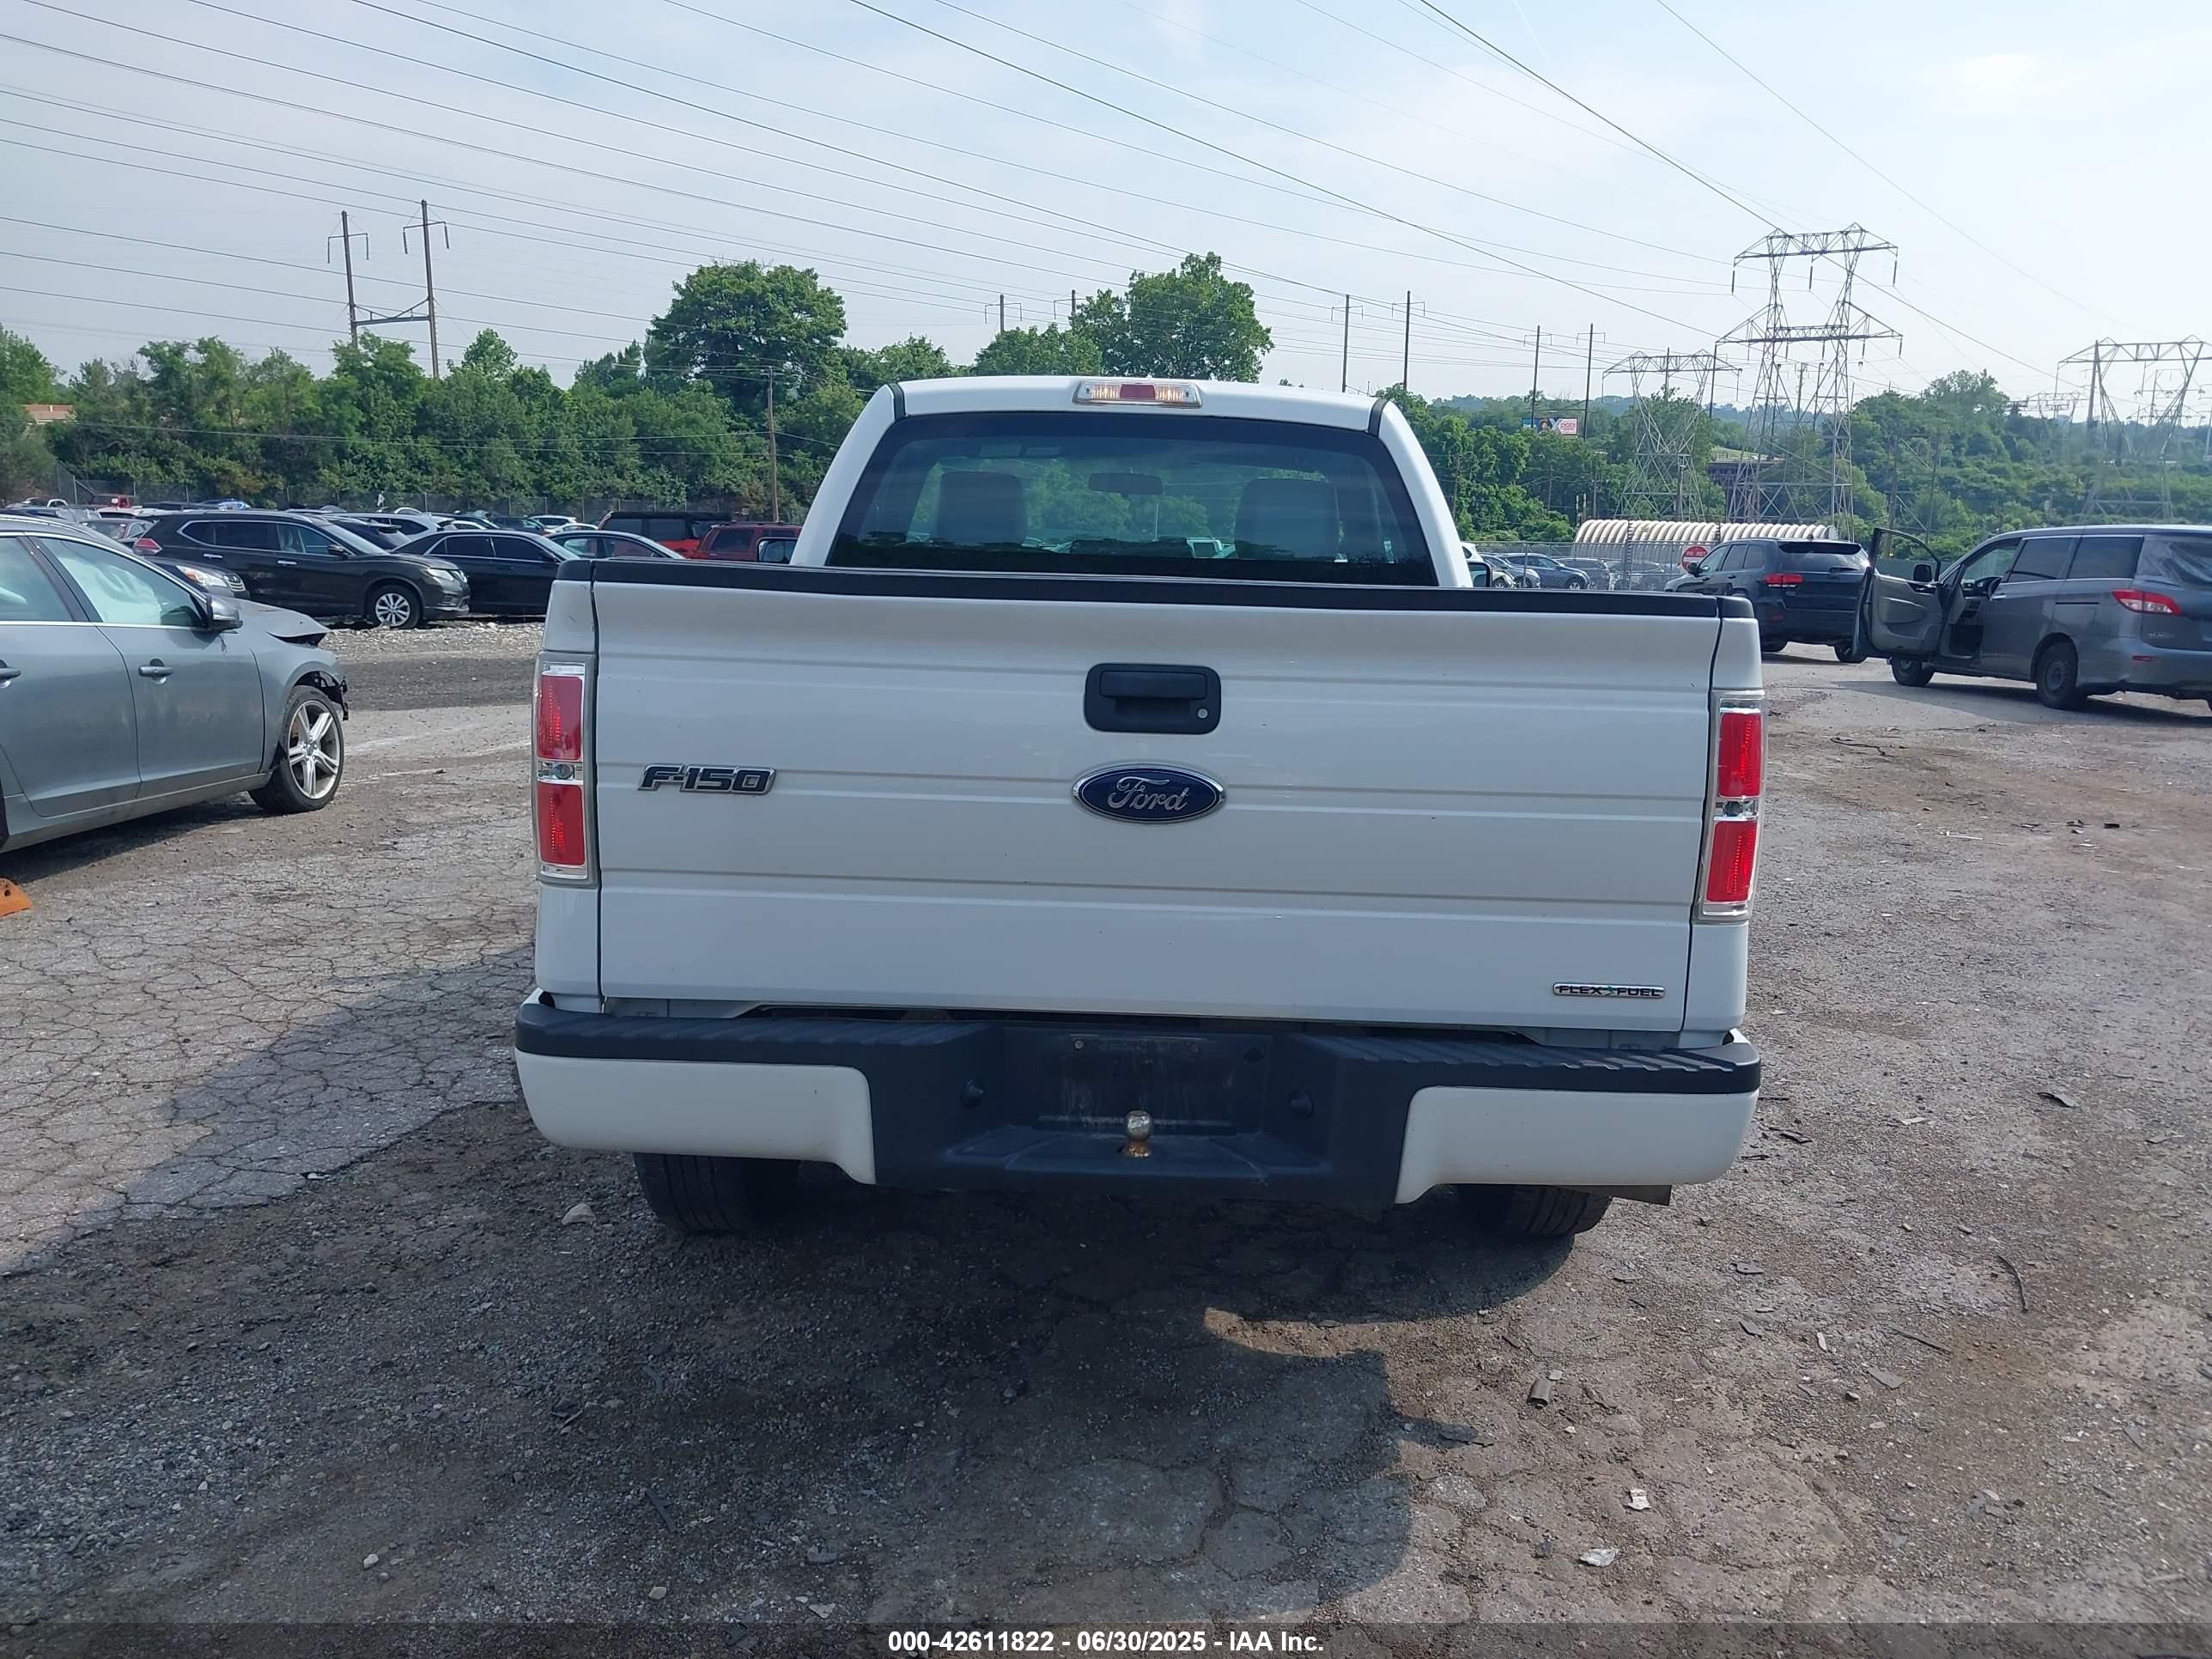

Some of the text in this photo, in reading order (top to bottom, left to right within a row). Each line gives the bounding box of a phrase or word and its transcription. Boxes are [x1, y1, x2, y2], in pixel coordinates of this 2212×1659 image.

[639, 763, 776, 795] F-150
[1107, 775, 1189, 811] Ford
[1555, 985, 1664, 997] FLEX FUEL
